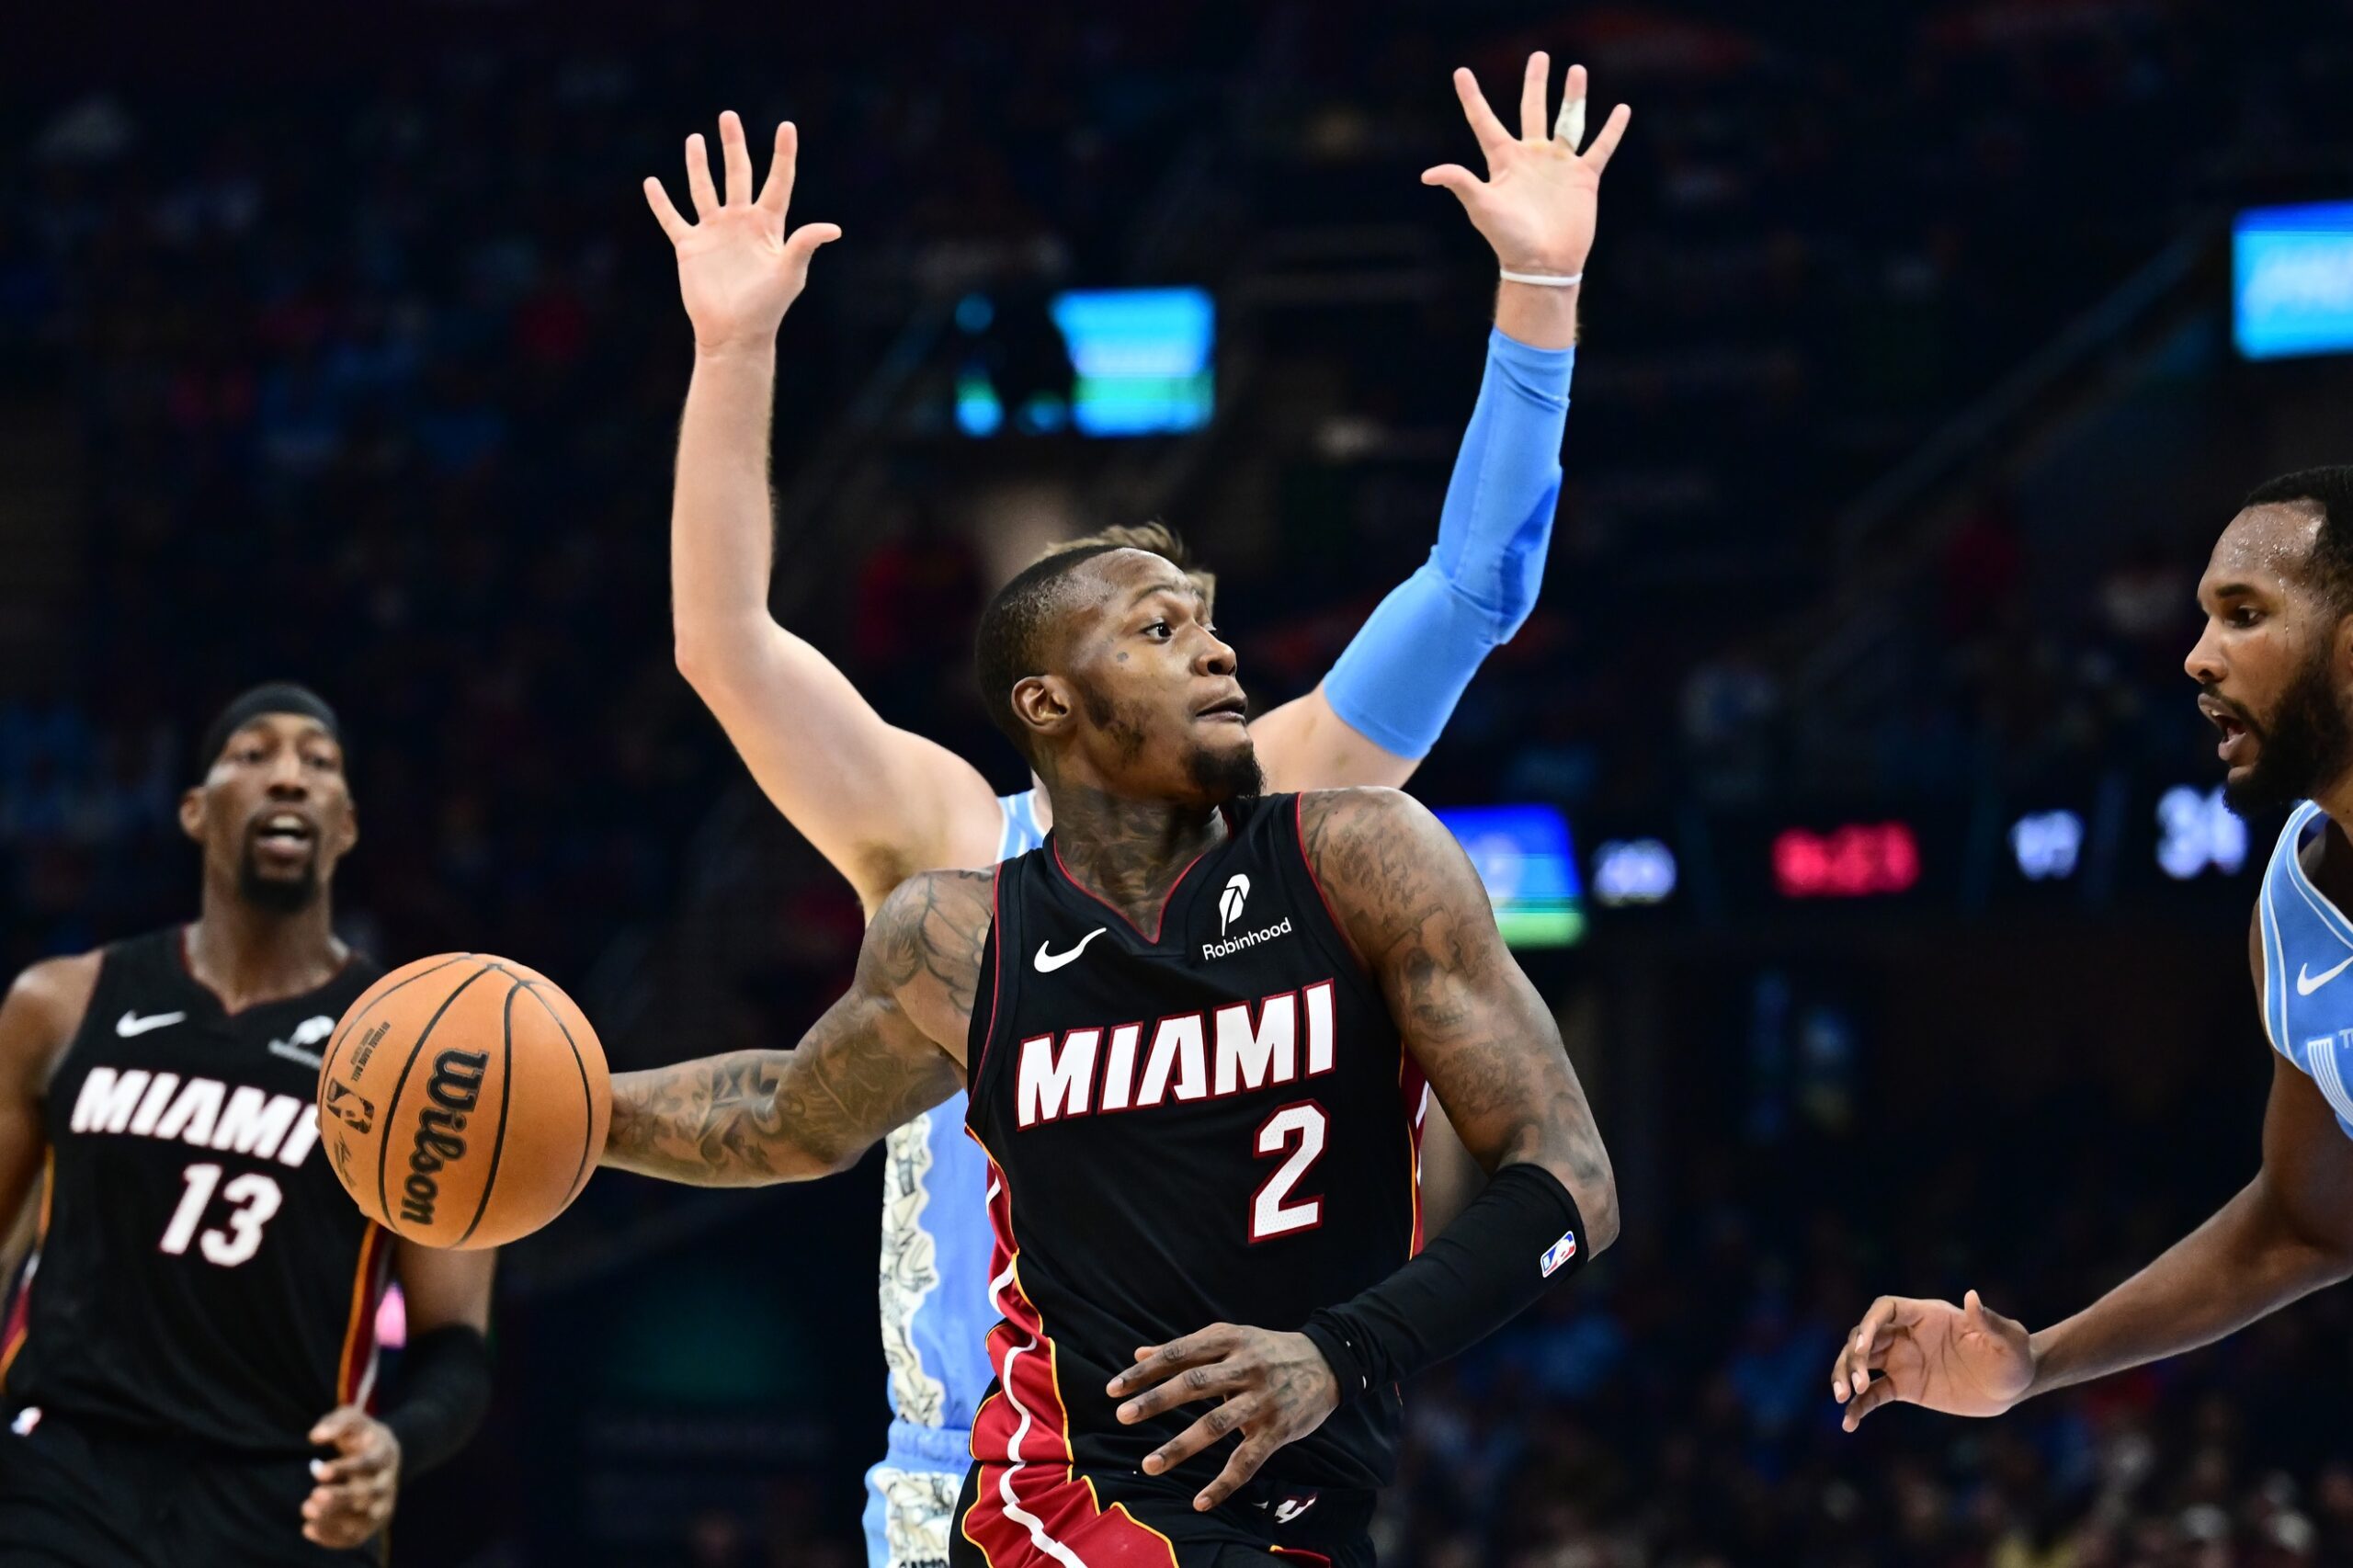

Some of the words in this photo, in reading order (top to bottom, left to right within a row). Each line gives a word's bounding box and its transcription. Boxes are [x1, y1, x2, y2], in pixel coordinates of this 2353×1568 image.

[1201, 916, 1292, 962] Robinhood
[1017, 980, 1336, 1130] MIAMI
[70, 1065, 322, 1169] MIAMI
[400, 1047, 490, 1226] Wilson
[1250, 1100, 1329, 1242] 2
[159, 1162, 283, 1267] 13
